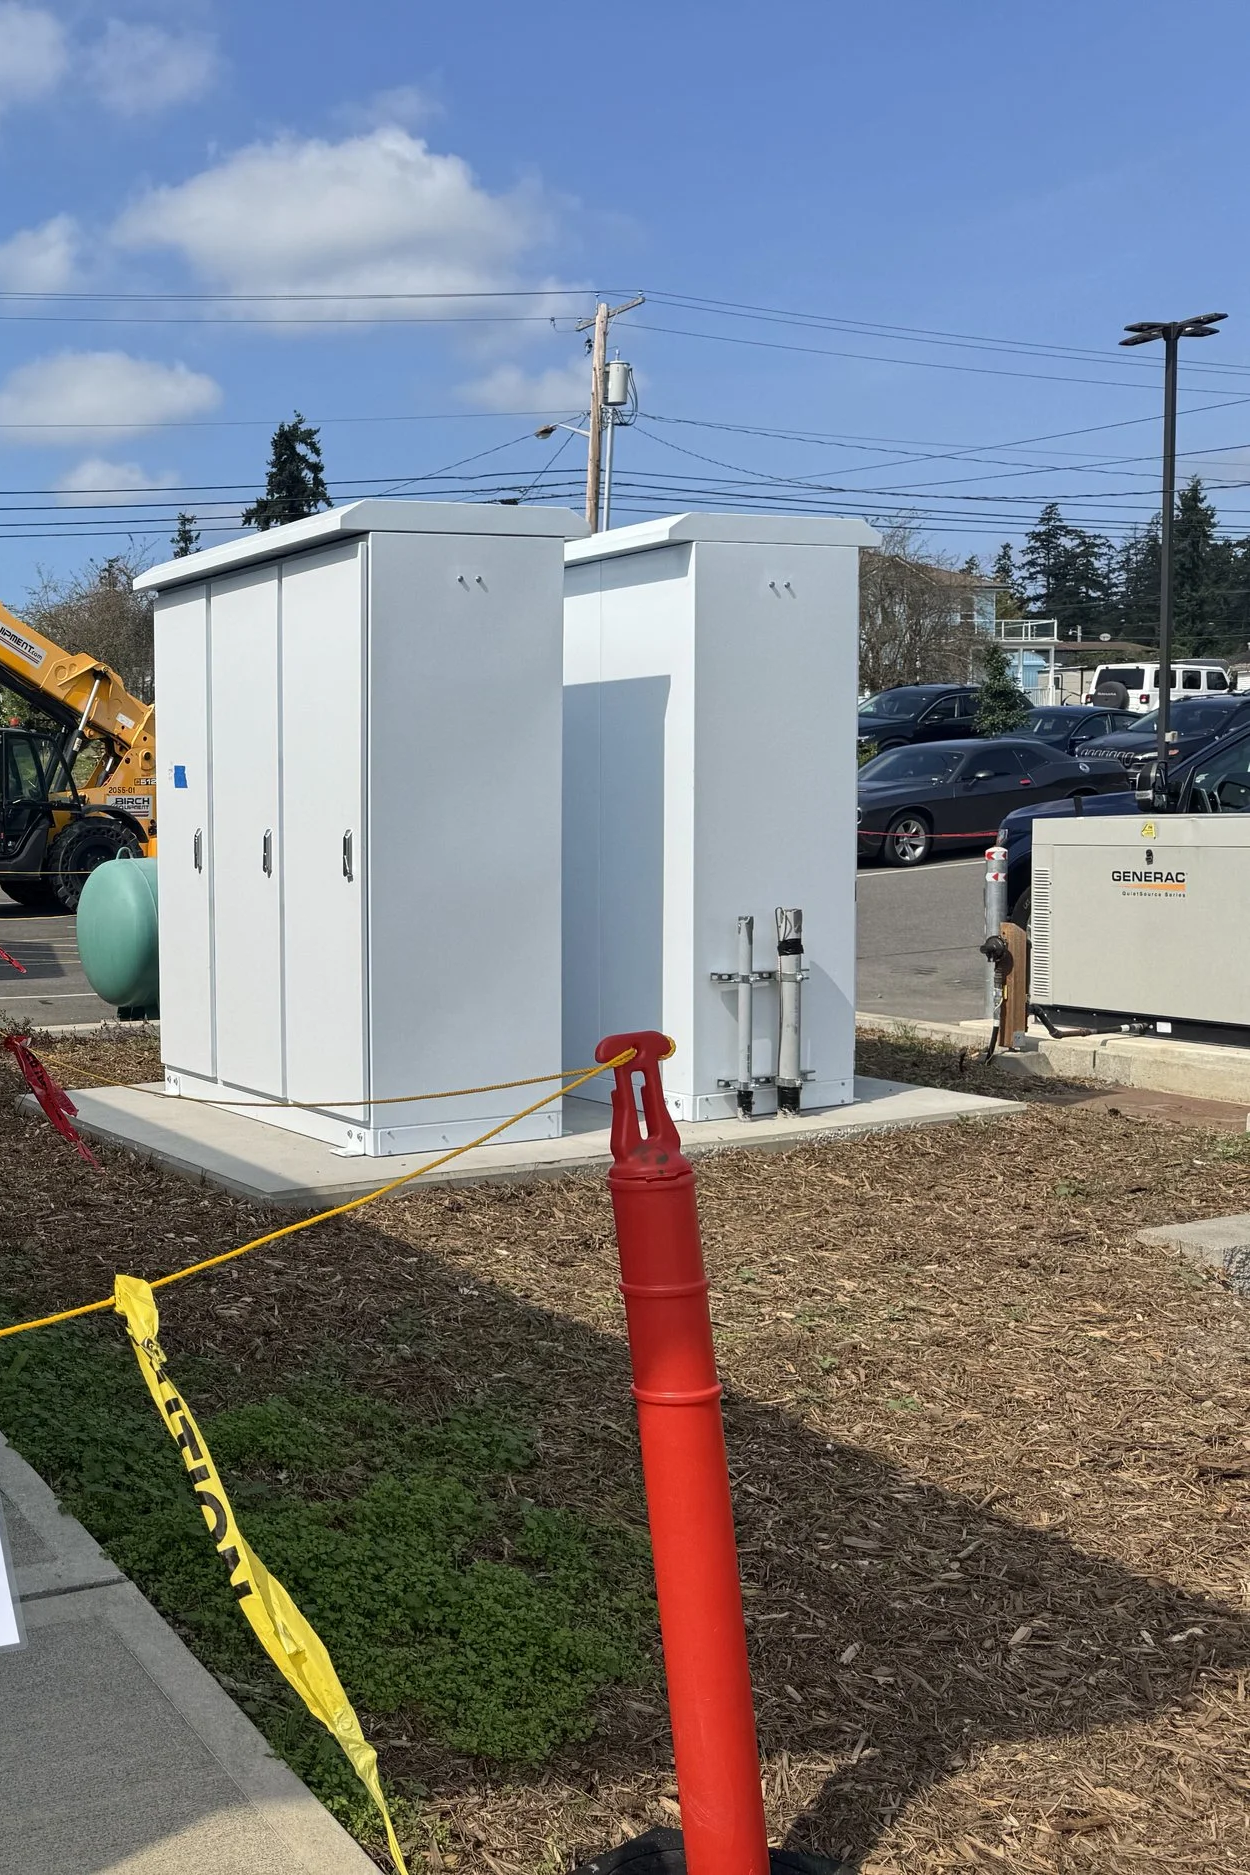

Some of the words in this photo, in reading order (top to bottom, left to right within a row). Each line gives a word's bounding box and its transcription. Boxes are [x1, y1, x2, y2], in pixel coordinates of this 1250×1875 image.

[108, 786, 136, 794] 2055-01
[115, 797, 150, 805] BIRCH
[1111, 870, 1186, 883] GENERAC
